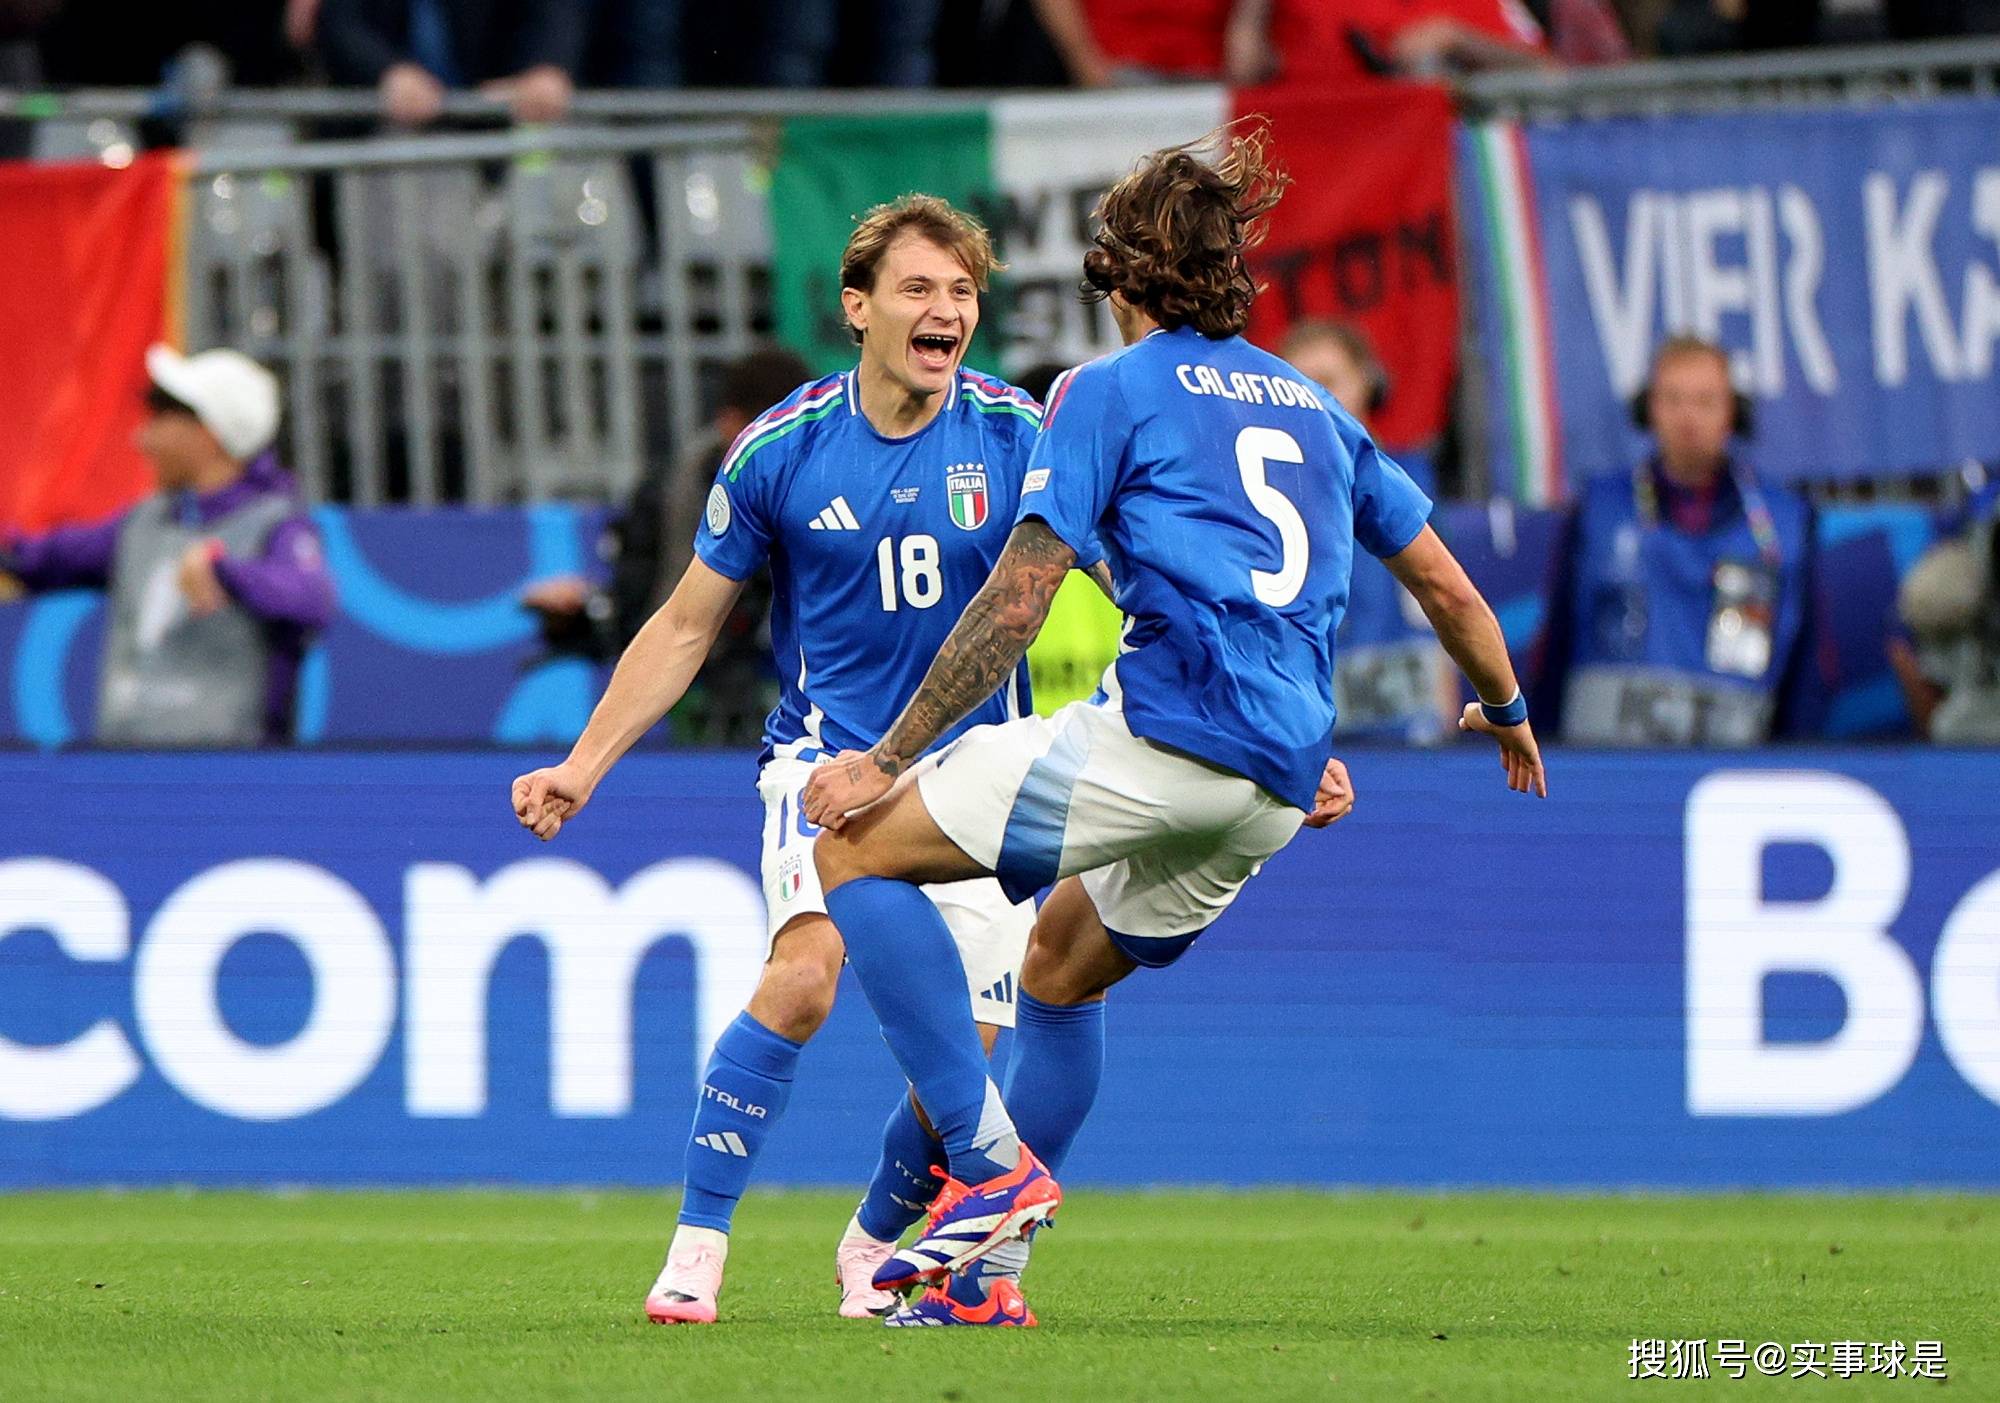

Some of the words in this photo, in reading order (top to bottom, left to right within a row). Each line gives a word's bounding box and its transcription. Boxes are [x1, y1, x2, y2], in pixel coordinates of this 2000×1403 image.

[1175, 363, 1325, 412] CALAFIORI
[950, 476, 984, 490] ITALIA
[1234, 426, 1310, 609] 5
[877, 533, 943, 612] 18
[0, 855, 770, 1121] com
[1683, 768, 2000, 1118] B
